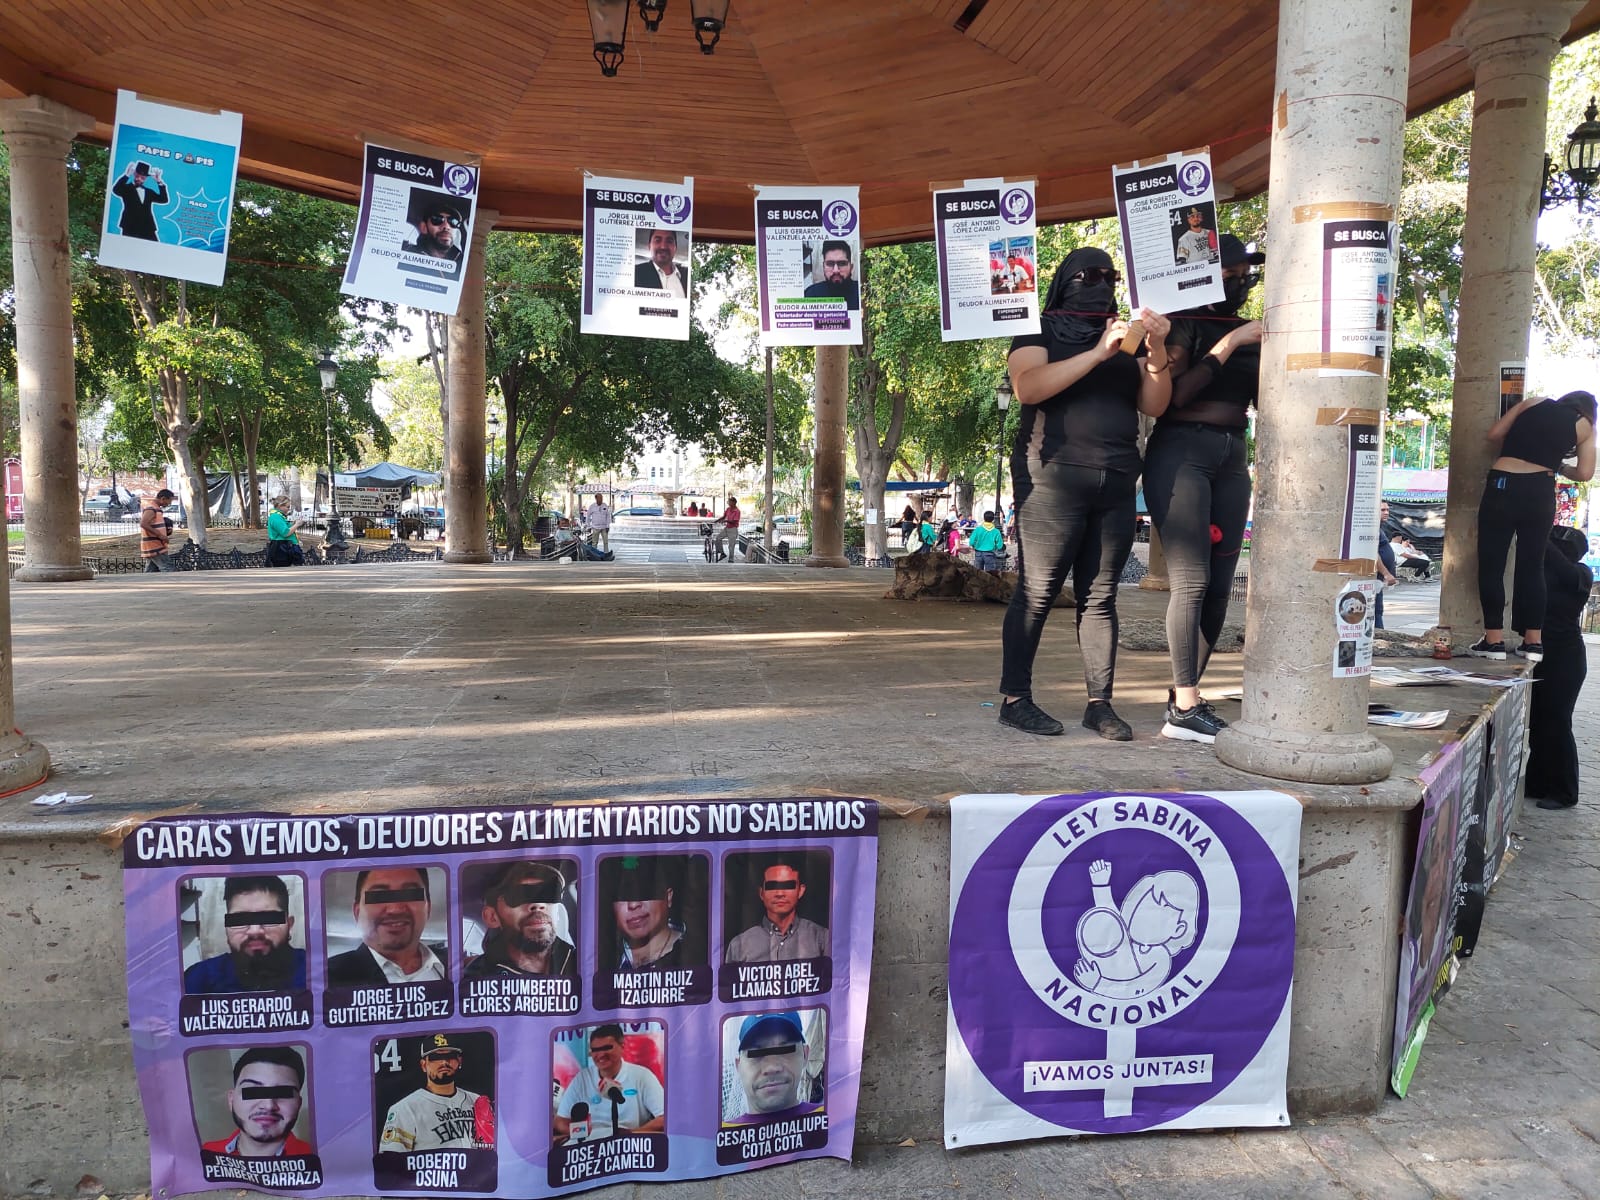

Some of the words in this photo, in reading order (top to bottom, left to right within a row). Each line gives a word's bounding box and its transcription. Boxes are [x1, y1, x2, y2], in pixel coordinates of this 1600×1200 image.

[137, 144, 170, 158] PAPIS
[378, 158, 392, 170] SE
[394, 161, 434, 178] BUSCA
[1126, 182, 1138, 192] SE
[1140, 176, 1174, 190] BUSCA
[596, 191, 610, 200] SE
[613, 192, 650, 204] BUSCA
[946, 202, 958, 212] SE
[961, 200, 996, 211] BUSCA
[1130, 206, 1151, 214] OSUNA
[1153, 199, 1182, 209] QUINTERO
[1150, 194, 1176, 204] ROBERTO
[608, 212, 629, 220] JORGE
[768, 210, 780, 219] SE
[783, 210, 818, 219] BUSCA
[1334, 231, 1349, 241] SE
[1352, 231, 1386, 241] BUSCA
[371, 248, 401, 259] DEUDOR
[403, 254, 453, 270] ALIMENTARIO
[1142, 273, 1164, 281] DEUDOR
[1166, 264, 1205, 276] ALIMENTARIO
[627, 289, 671, 298] ALIMENTARIO
[1359, 434, 1368, 443] SE
[136, 824, 233, 861] CARAS
[240, 818, 350, 856] VEMOS,
[357, 811, 504, 851] DEUDORES
[510, 804, 701, 842] ALIMENTARIOS
[708, 803, 743, 834] NO
[748, 800, 867, 834] SABEMOS
[1052, 807, 1100, 849] LEY
[1114, 802, 1213, 858] SABINA
[613, 972, 661, 990] MARTIN
[665, 970, 693, 987] RUIZ
[738, 964, 782, 982] VICTOR
[784, 962, 814, 980] ABEL
[351, 988, 393, 1007] JORGE
[396, 986, 426, 1003] LUIS
[470, 980, 498, 997] LUIS
[502, 979, 571, 995] HUMBERTO
[620, 986, 685, 1005] IZAGUIRRE
[732, 982, 782, 999] LLAMAS
[784, 977, 820, 994] LOPEZ
[201, 999, 229, 1015] LUIS
[232, 996, 292, 1014] GERARDO
[463, 996, 511, 1014] FLORES
[515, 995, 578, 1012] ARGUELLO
[1045, 974, 1203, 1024] NACIONAL
[184, 1013, 266, 1032] VALENZUELA
[270, 1010, 310, 1028] AYALA
[328, 1004, 404, 1024] GUTIERREZ
[407, 1000, 449, 1018] LOPEZ
[1032, 1065, 1114, 1086] ¡VAMOS
[1121, 1059, 1205, 1080] JUNTAS!
[716, 1128, 755, 1147] CESAR
[742, 1142, 772, 1159] COTA
[775, 1134, 803, 1152] COTA
[407, 1152, 467, 1171] ROBERTO
[565, 1146, 594, 1166] JOSE
[598, 1138, 652, 1158] ANTONIO
[216, 1156, 246, 1174] JESUS
[248, 1159, 306, 1174] EDUARDO
[562, 1160, 601, 1182] LOPEZ
[604, 1153, 655, 1172] CAMELO
[206, 1165, 260, 1185] PEIMBERT
[262, 1170, 321, 1187] BARRAZA
[415, 1170, 458, 1188] OSUNA
